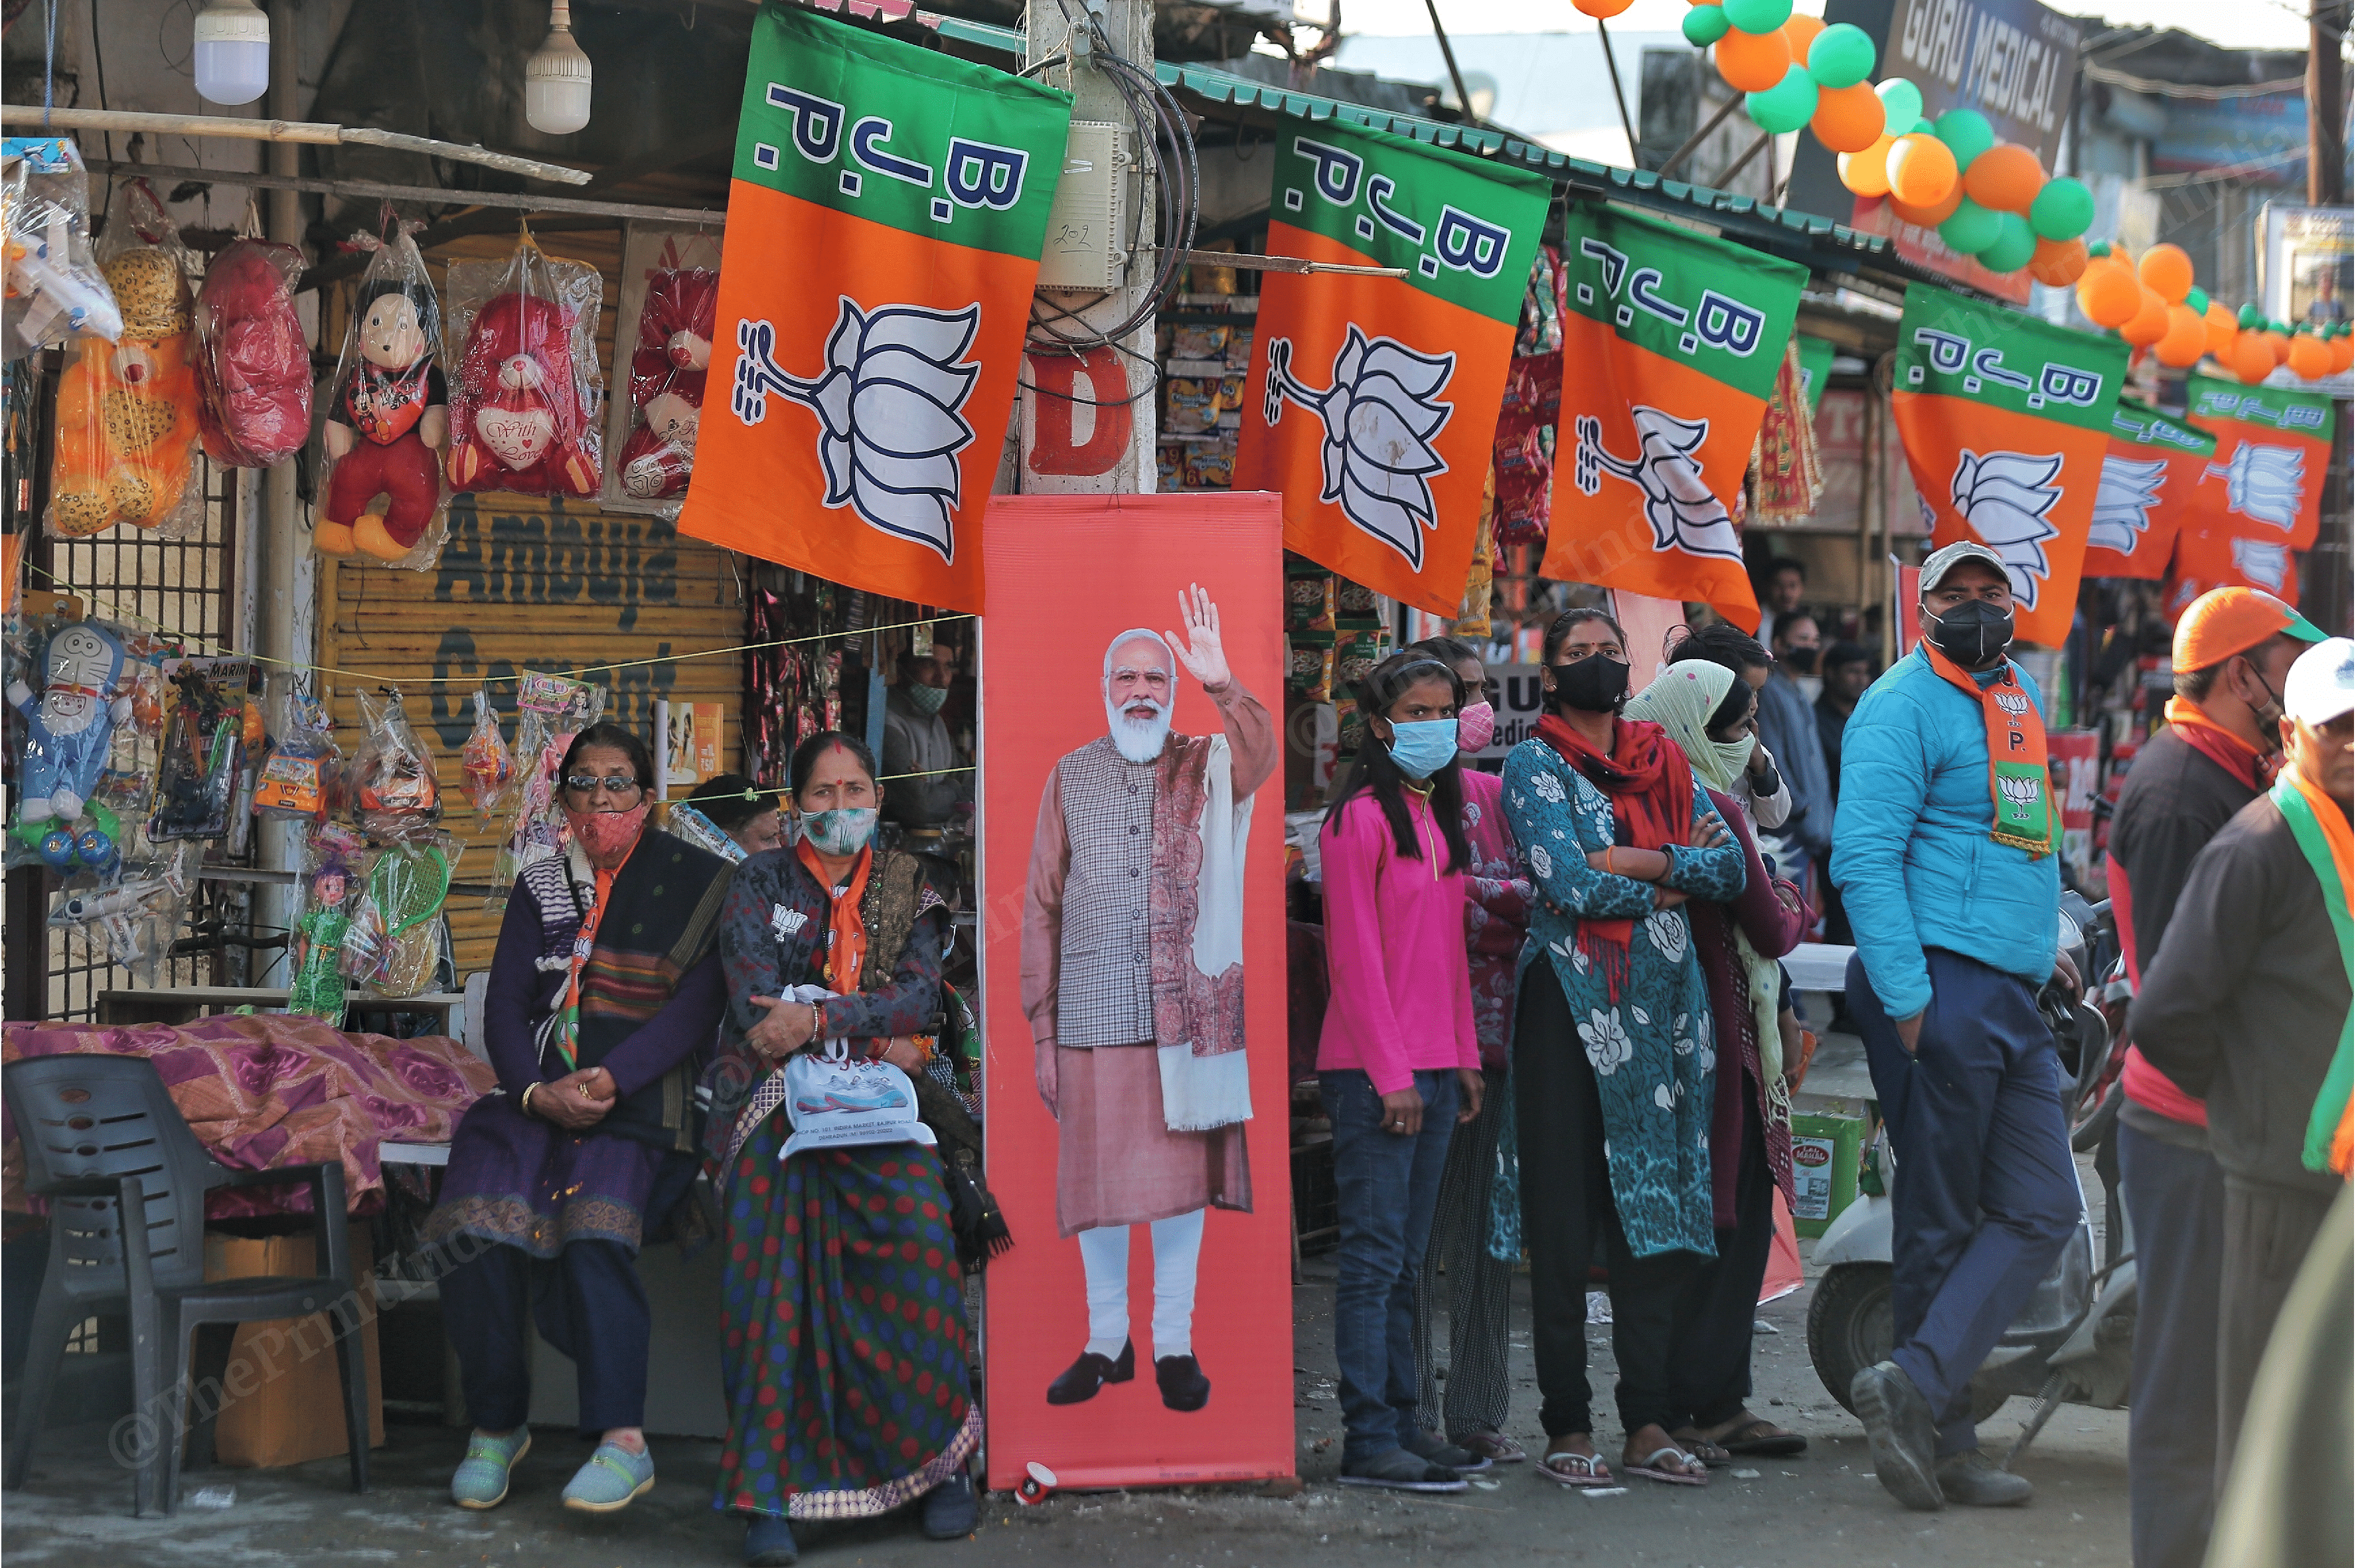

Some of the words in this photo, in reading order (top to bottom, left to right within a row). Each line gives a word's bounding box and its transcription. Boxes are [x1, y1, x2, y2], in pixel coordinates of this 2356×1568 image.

[1966, 11, 2061, 132] MEDICAL
[487, 420, 536, 438] With
[499, 446, 542, 461] Love
